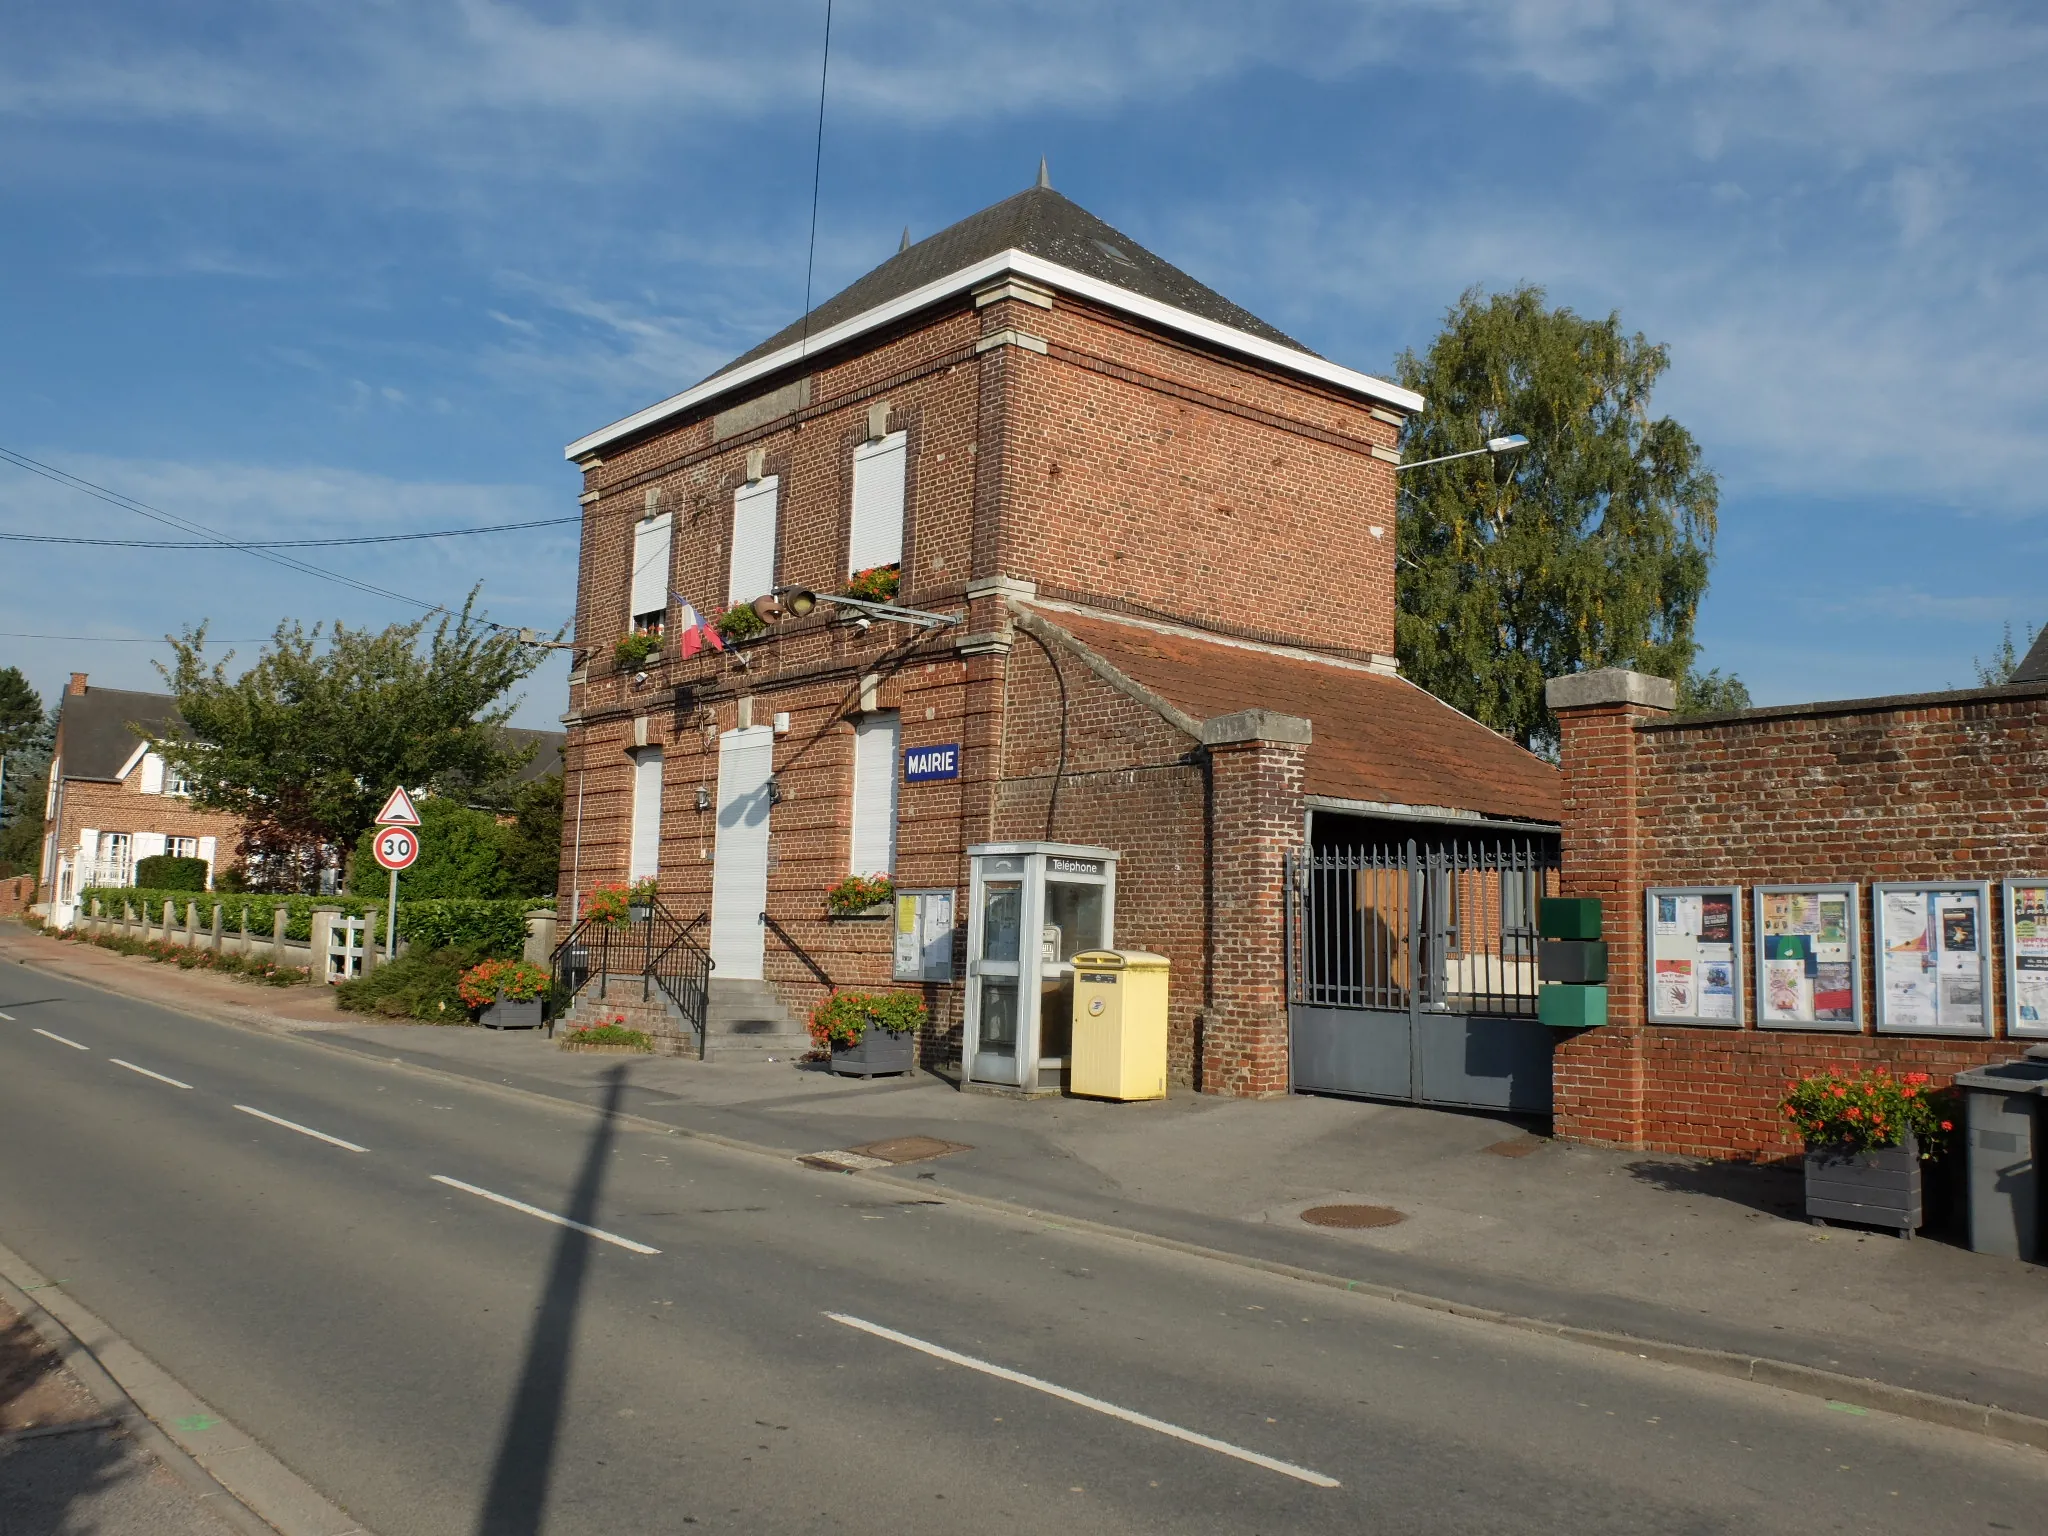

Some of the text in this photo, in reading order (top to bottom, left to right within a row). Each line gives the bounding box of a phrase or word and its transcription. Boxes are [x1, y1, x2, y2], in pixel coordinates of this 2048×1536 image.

[908, 751, 954, 775] MAIRIE
[383, 839, 410, 856] 30
[1052, 859, 1097, 873] Téléphone
